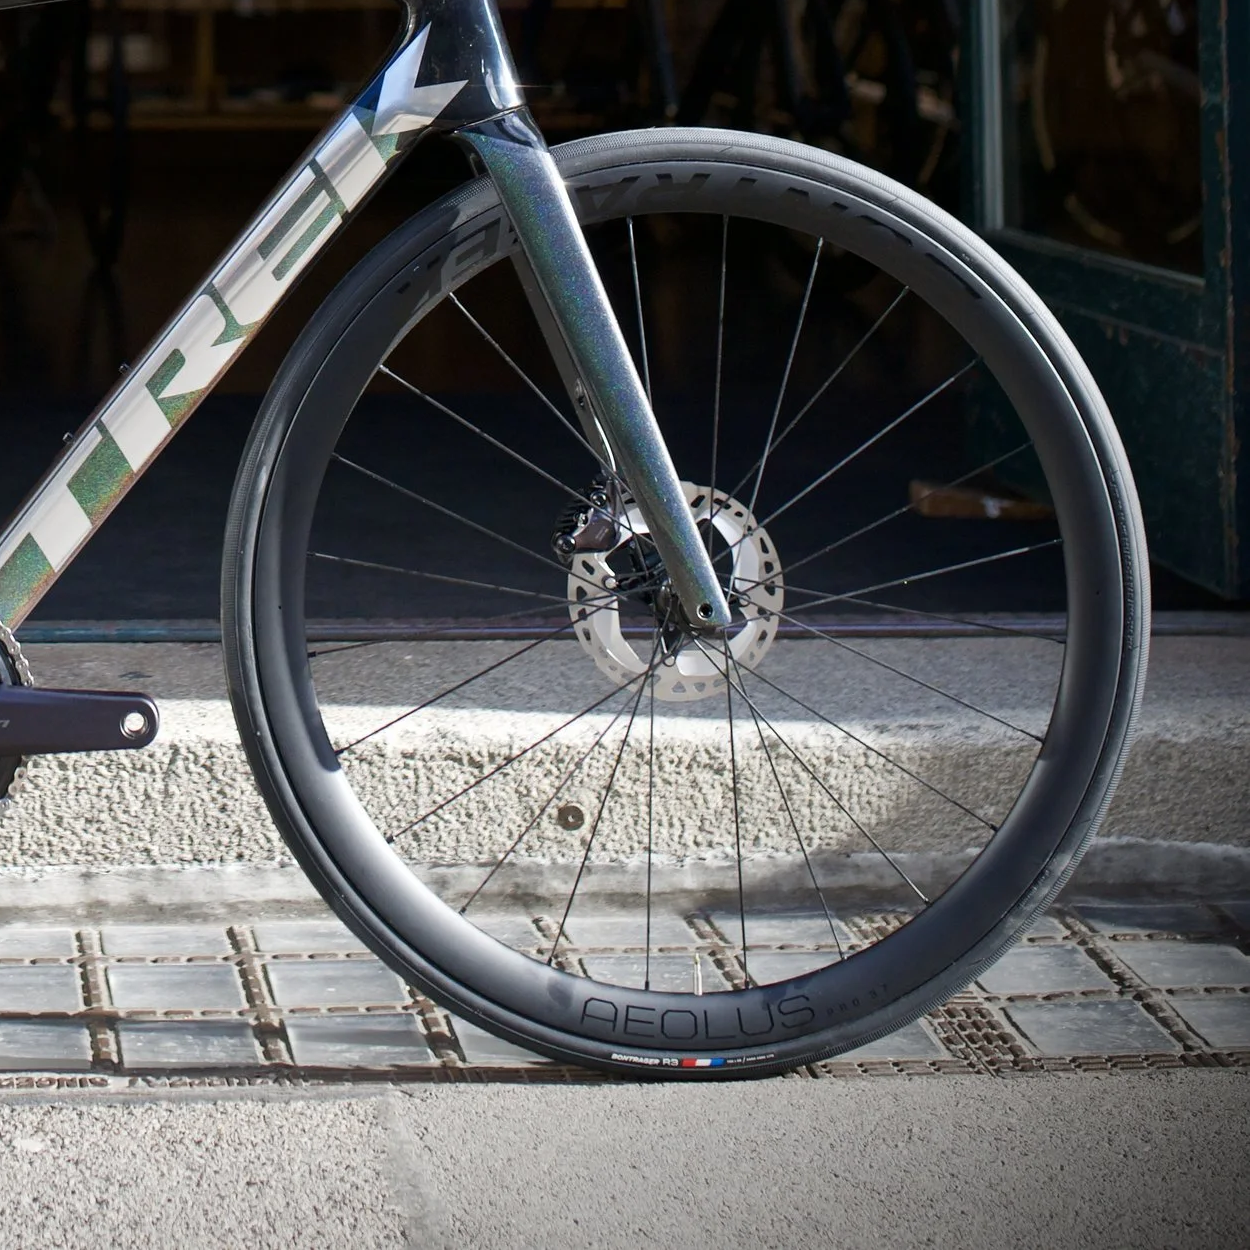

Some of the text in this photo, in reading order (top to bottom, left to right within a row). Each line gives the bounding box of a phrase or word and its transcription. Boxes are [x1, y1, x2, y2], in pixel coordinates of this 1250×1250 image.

[579, 994, 816, 1041] AEOLUS
[611, 1053, 680, 1067] BONTRAGER R3
